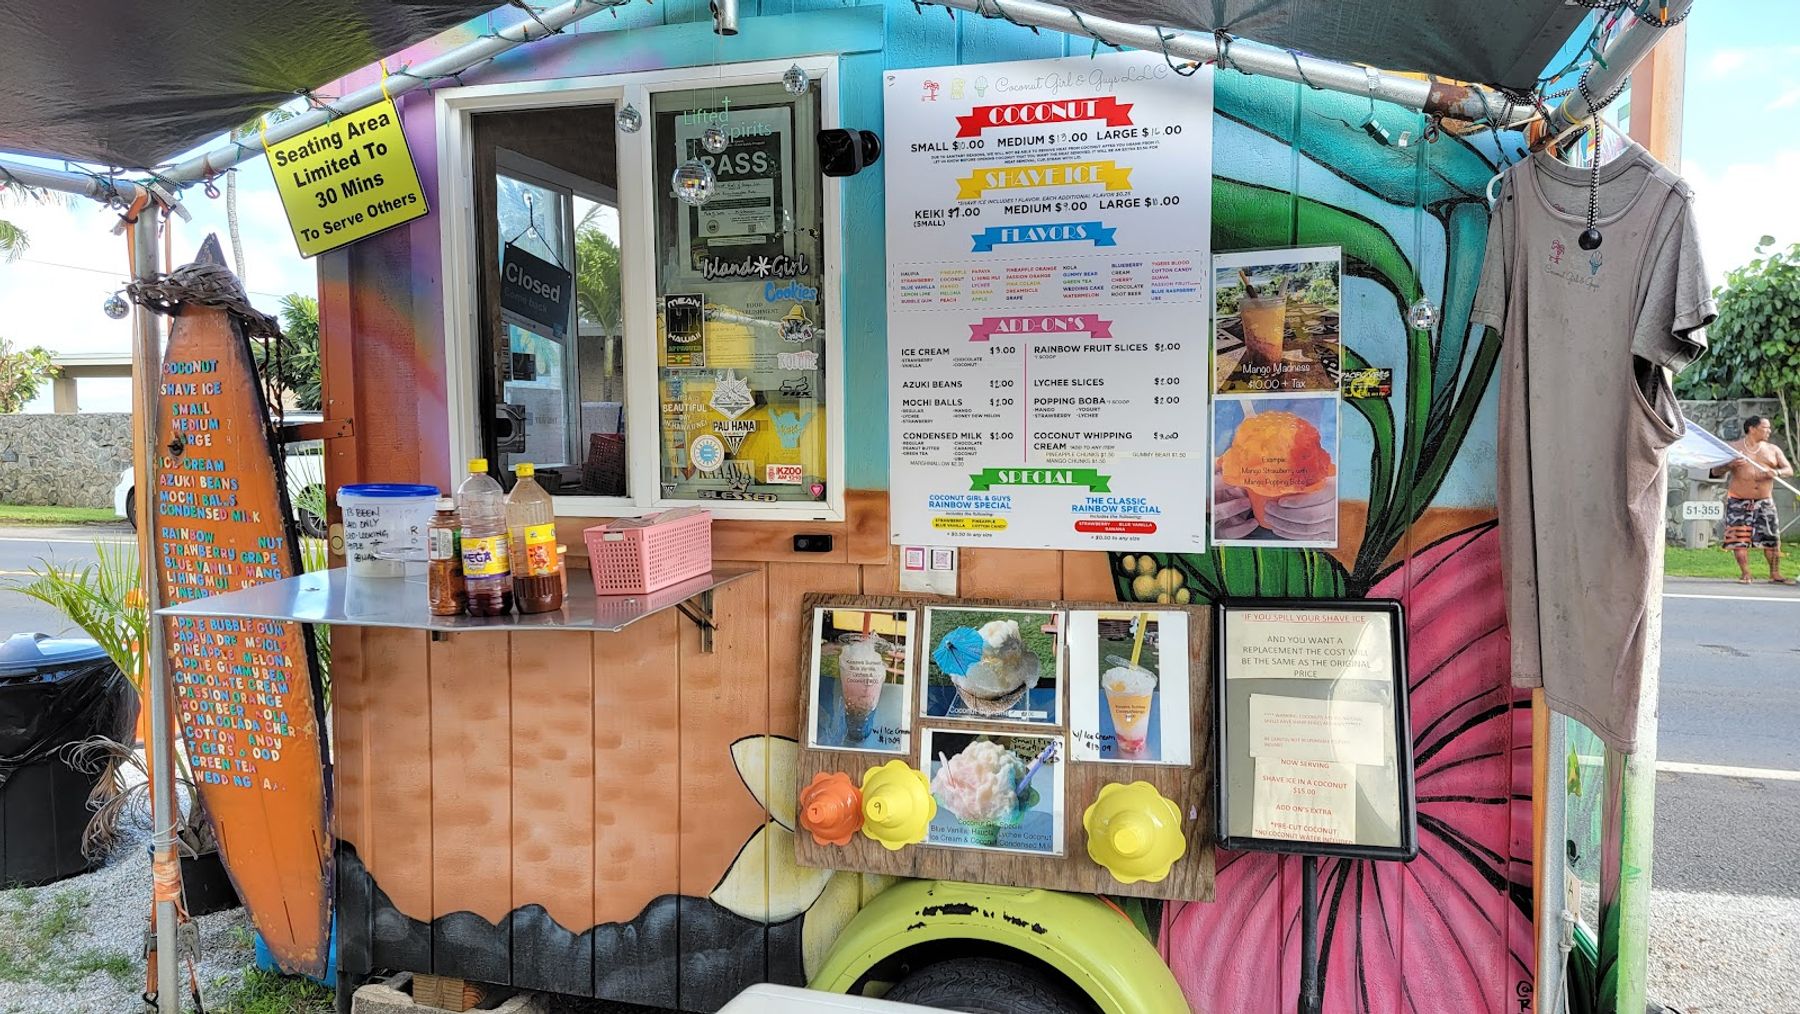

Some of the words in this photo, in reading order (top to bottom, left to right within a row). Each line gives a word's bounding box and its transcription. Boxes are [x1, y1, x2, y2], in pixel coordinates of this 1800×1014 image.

[995, 76, 1043, 92] Coconut
[1045, 72, 1072, 95] Girl
[1088, 69, 1120, 92] Guys
[1121, 64, 1168, 82] LLC
[684, 96, 731, 125] Lifted
[988, 100, 1099, 124] COCONUT
[275, 132, 343, 167] Seating
[348, 113, 390, 140] Area
[1096, 128, 1138, 140] LARGE
[911, 141, 948, 153] SMALL
[997, 136, 1045, 148] MEDIUM
[293, 150, 361, 188] Limited
[363, 142, 388, 160] To
[701, 151, 768, 175] PASS
[985, 168, 1059, 188] SHAVE
[1064, 166, 1103, 183] ICE
[315, 188, 338, 208] 30
[342, 173, 384, 198] Mins
[1004, 203, 1051, 215] MEDIUM
[1099, 198, 1140, 210] LARGE
[301, 228, 320, 242] To
[323, 213, 364, 235] Serve
[367, 193, 417, 218] Others
[914, 209, 944, 219] KEIKI
[913, 220, 946, 228] (SMALL)
[1001, 224, 1087, 242] FLAVORS
[703, 256, 755, 279] Island
[771, 254, 809, 277] Girl
[506, 262, 561, 303] Closed
[764, 279, 817, 302] Cookies
[667, 297, 701, 308] MEAN
[996, 317, 1085, 333] ADD-ON'S
[668, 332, 701, 343] HAWAII
[901, 348, 915, 356] ICE
[918, 348, 950, 356] CREAM
[1034, 346, 1081, 354] RAINBOW
[1083, 345, 1111, 353] FRUIT
[163, 360, 218, 374] COCONUT
[1242, 363, 1271, 377] Mango
[1273, 362, 1311, 375] Madness
[160, 383, 198, 396] SHAVE
[202, 381, 222, 395] ICE
[932, 380, 963, 388] BEANS
[1071, 378, 1104, 386] SLICES
[1292, 379, 1306, 389] Tax
[663, 403, 707, 412] BEAUTIFUL
[902, 399, 932, 407] MOCHI
[1078, 397, 1106, 405] BOBA
[172, 402, 211, 416] SMALL
[172, 418, 220, 431] MEDIUM
[714, 421, 729, 431] PAU
[731, 421, 755, 431] HANA
[902, 432, 958, 440] CONDENSED
[961, 432, 982, 440] MILK
[1033, 432, 1080, 440] COCONUT
[1083, 432, 1133, 440] WHIPPING
[183, 457, 225, 472] CREAM
[777, 467, 802, 475] KZOO
[160, 473, 195, 488] AZUKI
[199, 475, 239, 490] BEANS
[998, 470, 1078, 484] SPECIAL
[160, 490, 198, 505] MOCHI
[698, 490, 777, 502] BLESSED
[1106, 497, 1147, 505] CLASSIC
[160, 503, 228, 521] CONDENSED
[928, 501, 972, 509] RAINBOW
[974, 501, 1012, 509] SPECIAL
[1071, 505, 1118, 513] RAINBOW
[1121, 505, 1161, 513] SPECIAL
[1686, 505, 1720, 515] 51-355
[162, 527, 215, 543] RAINBOW
[258, 537, 284, 549] NUT
[163, 543, 236, 561] STRAWBERRY
[240, 551, 278, 565] GRAPE
[164, 556, 193, 572] BLUE
[210, 617, 253, 632] BUBBLE
[257, 623, 284, 636] GUM
[173, 630, 213, 645] PAPAYA
[173, 642, 235, 661] PINEAPPLE
[242, 652, 293, 668] MELONA
[1242, 647, 1303, 655] REPLACEMENT
[217, 661, 259, 678] GUMMY
[175, 670, 244, 690] CHOCOLATE
[248, 679, 289, 694] CREAM
[179, 685, 230, 701] PASSION
[232, 691, 283, 708] ORANGE
[181, 699, 245, 717] ROOTBEER
[183, 712, 214, 726] PINA
[215, 715, 261, 732] COLADA
[186, 725, 235, 744] COTTON
[1084, 731, 1094, 740] Ice
[1095, 732, 1116, 741] Cream
[191, 755, 231, 770] GREEN
[1281, 758, 1298, 766] NOW
[1300, 761, 1329, 769] SERVING
[1262, 775, 1284, 783] SHAVE
[1313, 780, 1347, 789] COCONUT
[874, 801, 881, 814] 9
[1311, 807, 1332, 815] EXTRA
[1269, 831, 1298, 839] COCONUT
[1304, 825, 1336, 835] COCONUT
